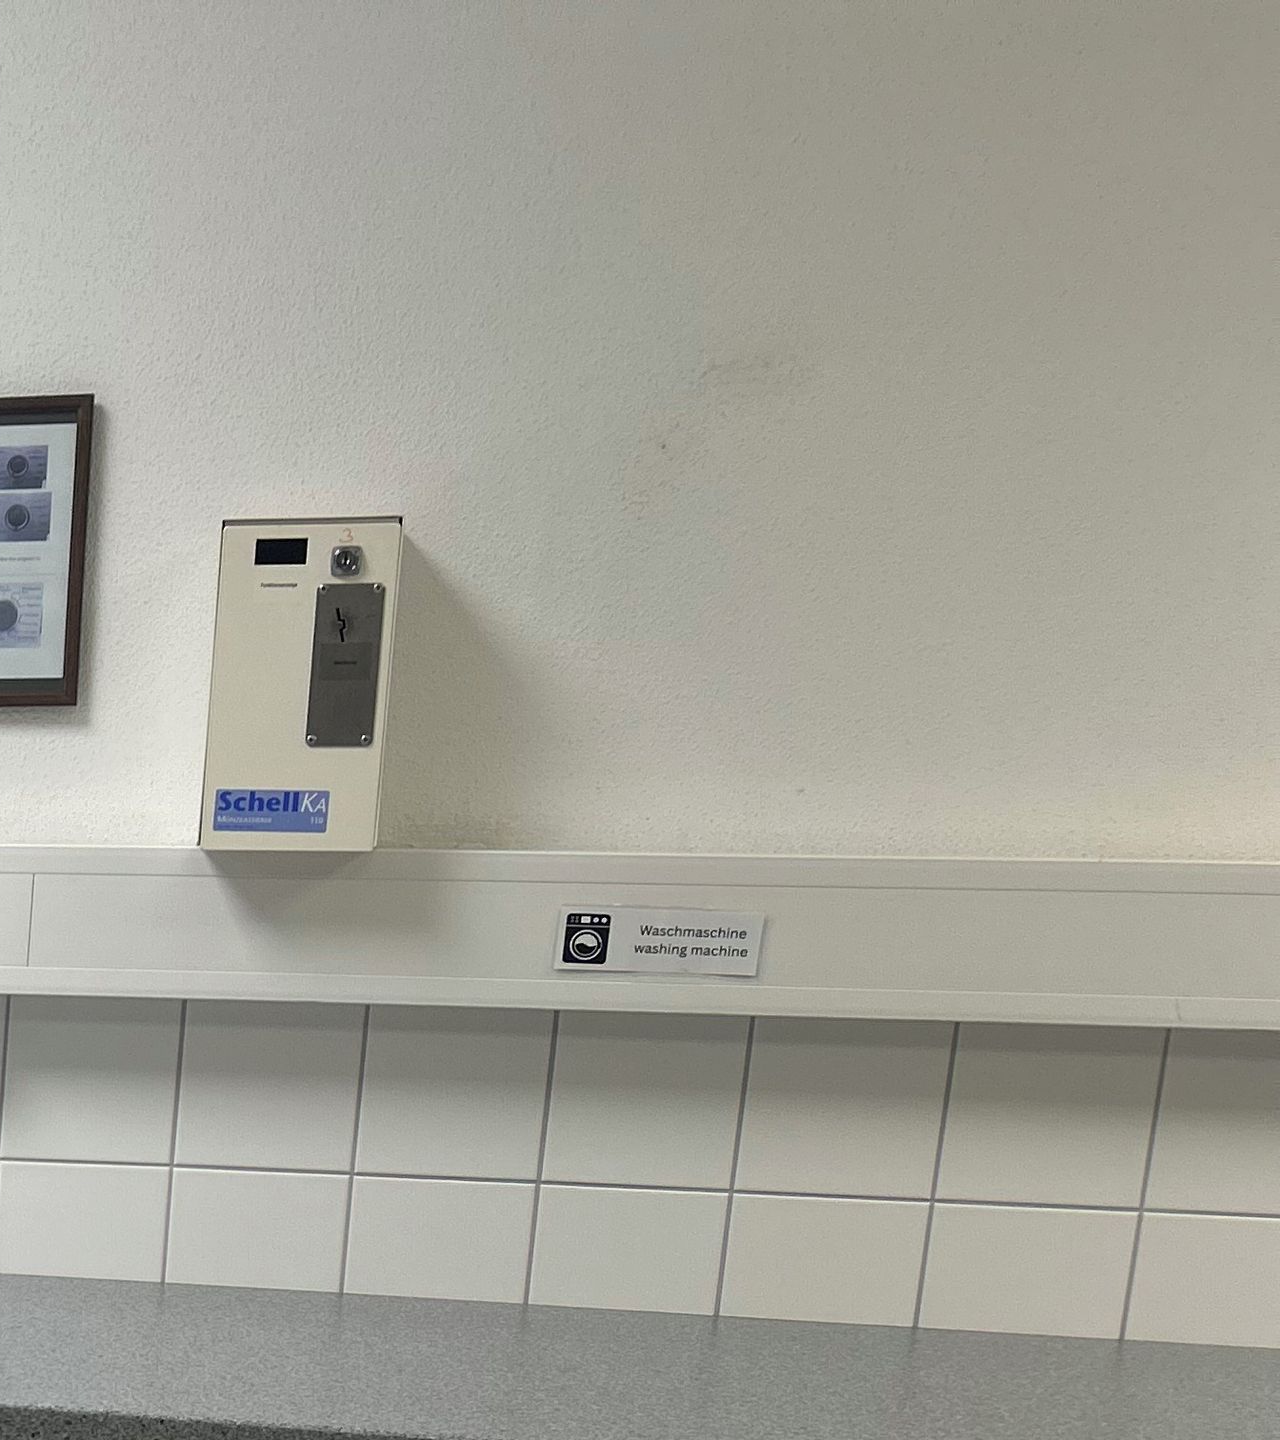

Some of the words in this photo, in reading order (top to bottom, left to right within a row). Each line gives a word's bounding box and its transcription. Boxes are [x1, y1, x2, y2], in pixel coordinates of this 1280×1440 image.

[640, 924, 748, 940] Waschmaschine
[634, 943, 687, 958] washing
[690, 945, 748, 958] machine
